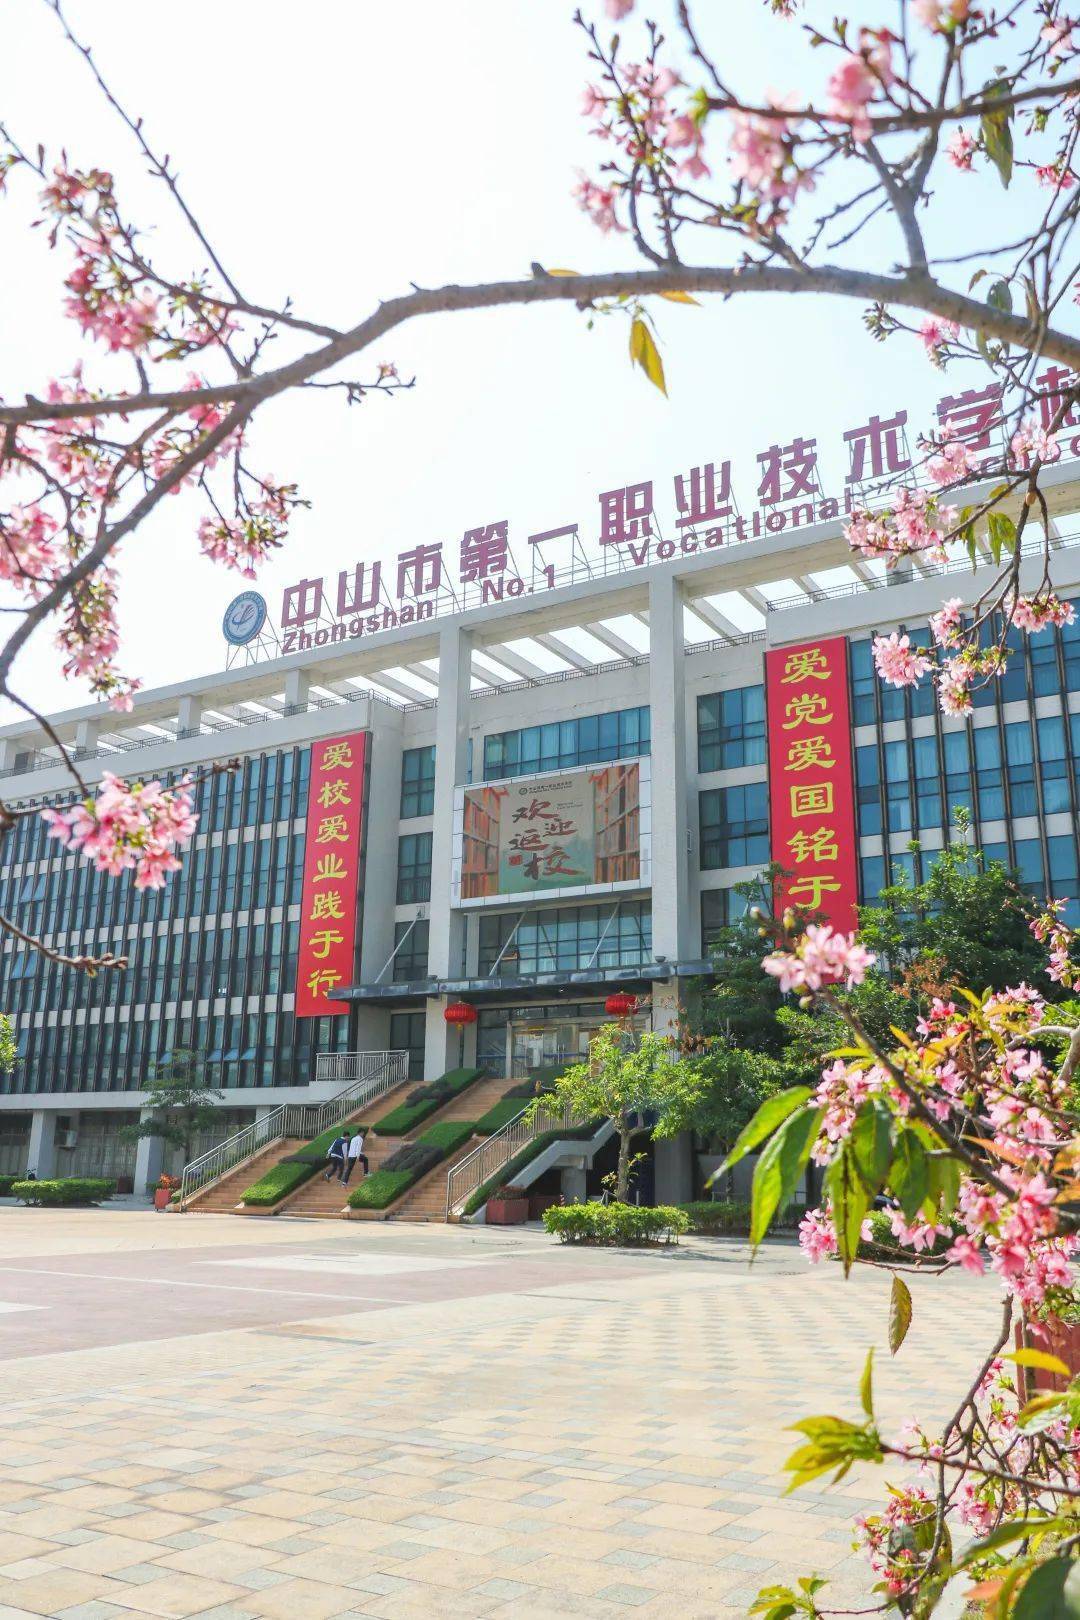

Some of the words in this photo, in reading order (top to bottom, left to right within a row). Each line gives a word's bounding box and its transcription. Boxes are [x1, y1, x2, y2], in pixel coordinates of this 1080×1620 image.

[281, 599, 434, 655] Zhongshan
[307, 741, 353, 998] 爱校爱业践于行
